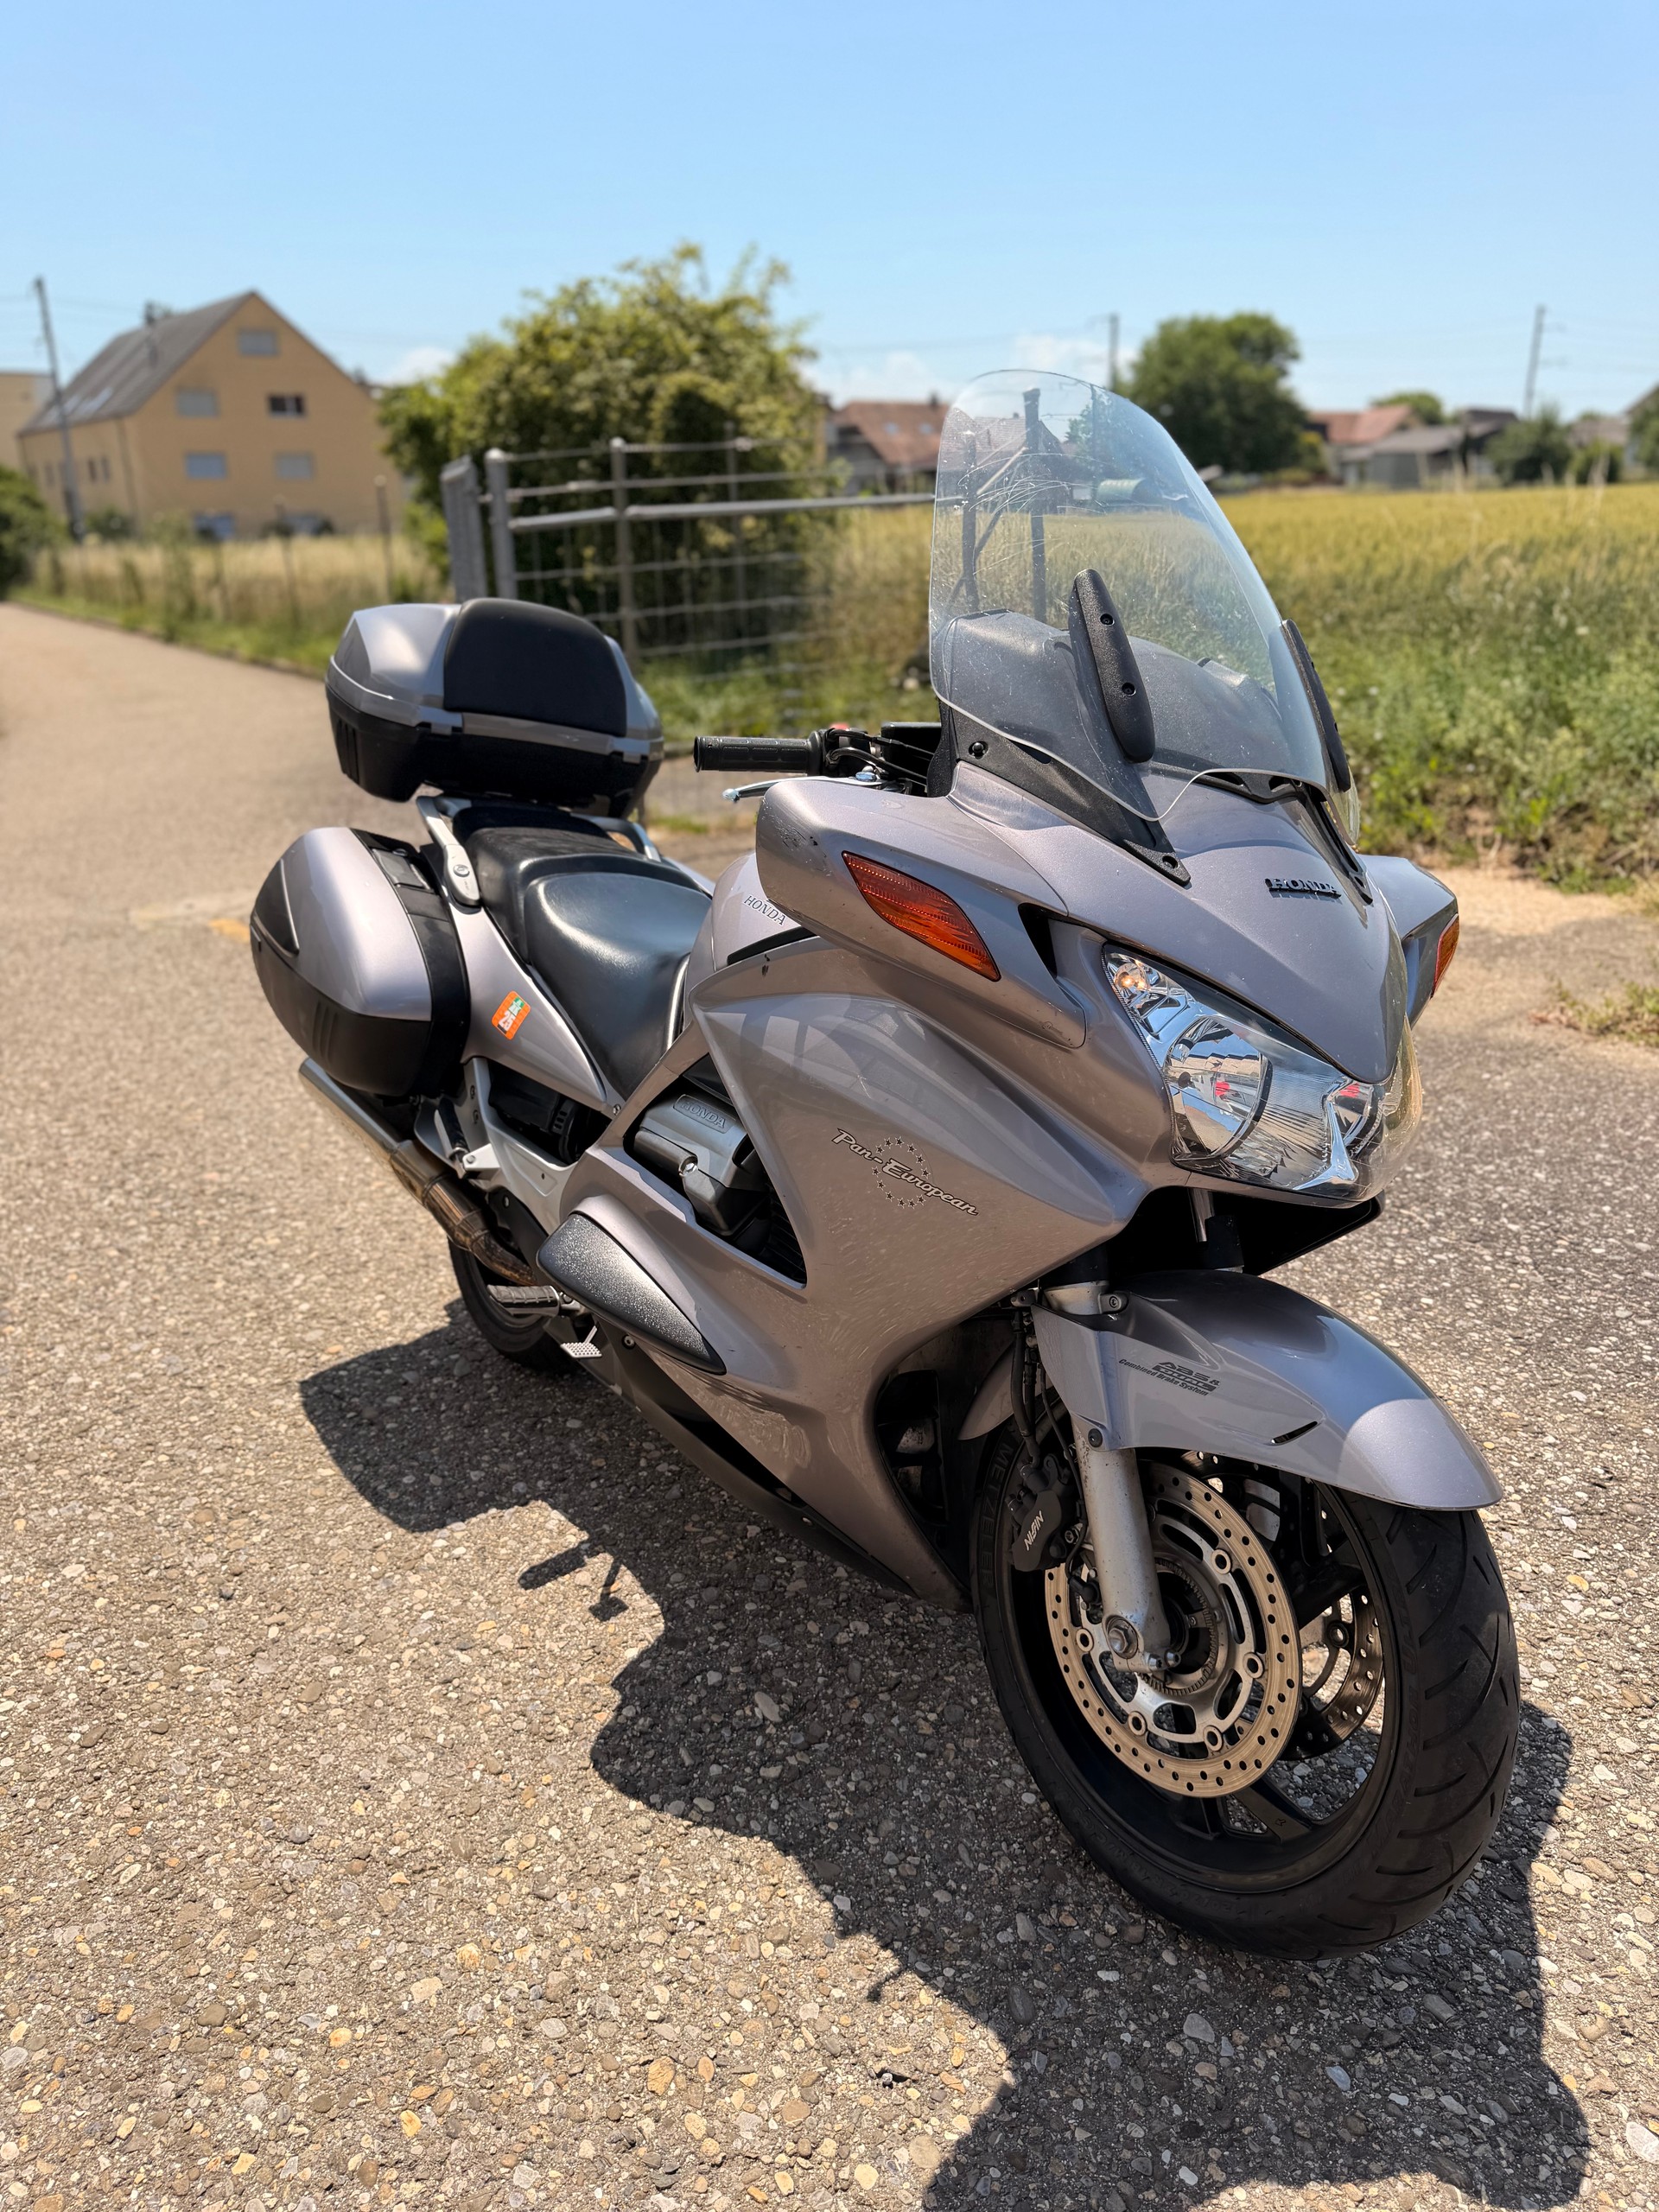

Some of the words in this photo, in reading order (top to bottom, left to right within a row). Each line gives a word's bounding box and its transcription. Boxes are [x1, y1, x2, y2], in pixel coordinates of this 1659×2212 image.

[1265, 878, 1341, 898] HONDA
[744, 895, 786, 925] HONDA
[681, 1102, 726, 1128] HONDA
[1118, 1358, 1158, 1376] Combined
[1156, 1373, 1179, 1386] Brake
[1179, 1380, 1209, 1396] System
[1158, 1361, 1211, 1382] ABS
[980, 1442, 1014, 1587] METZELER
